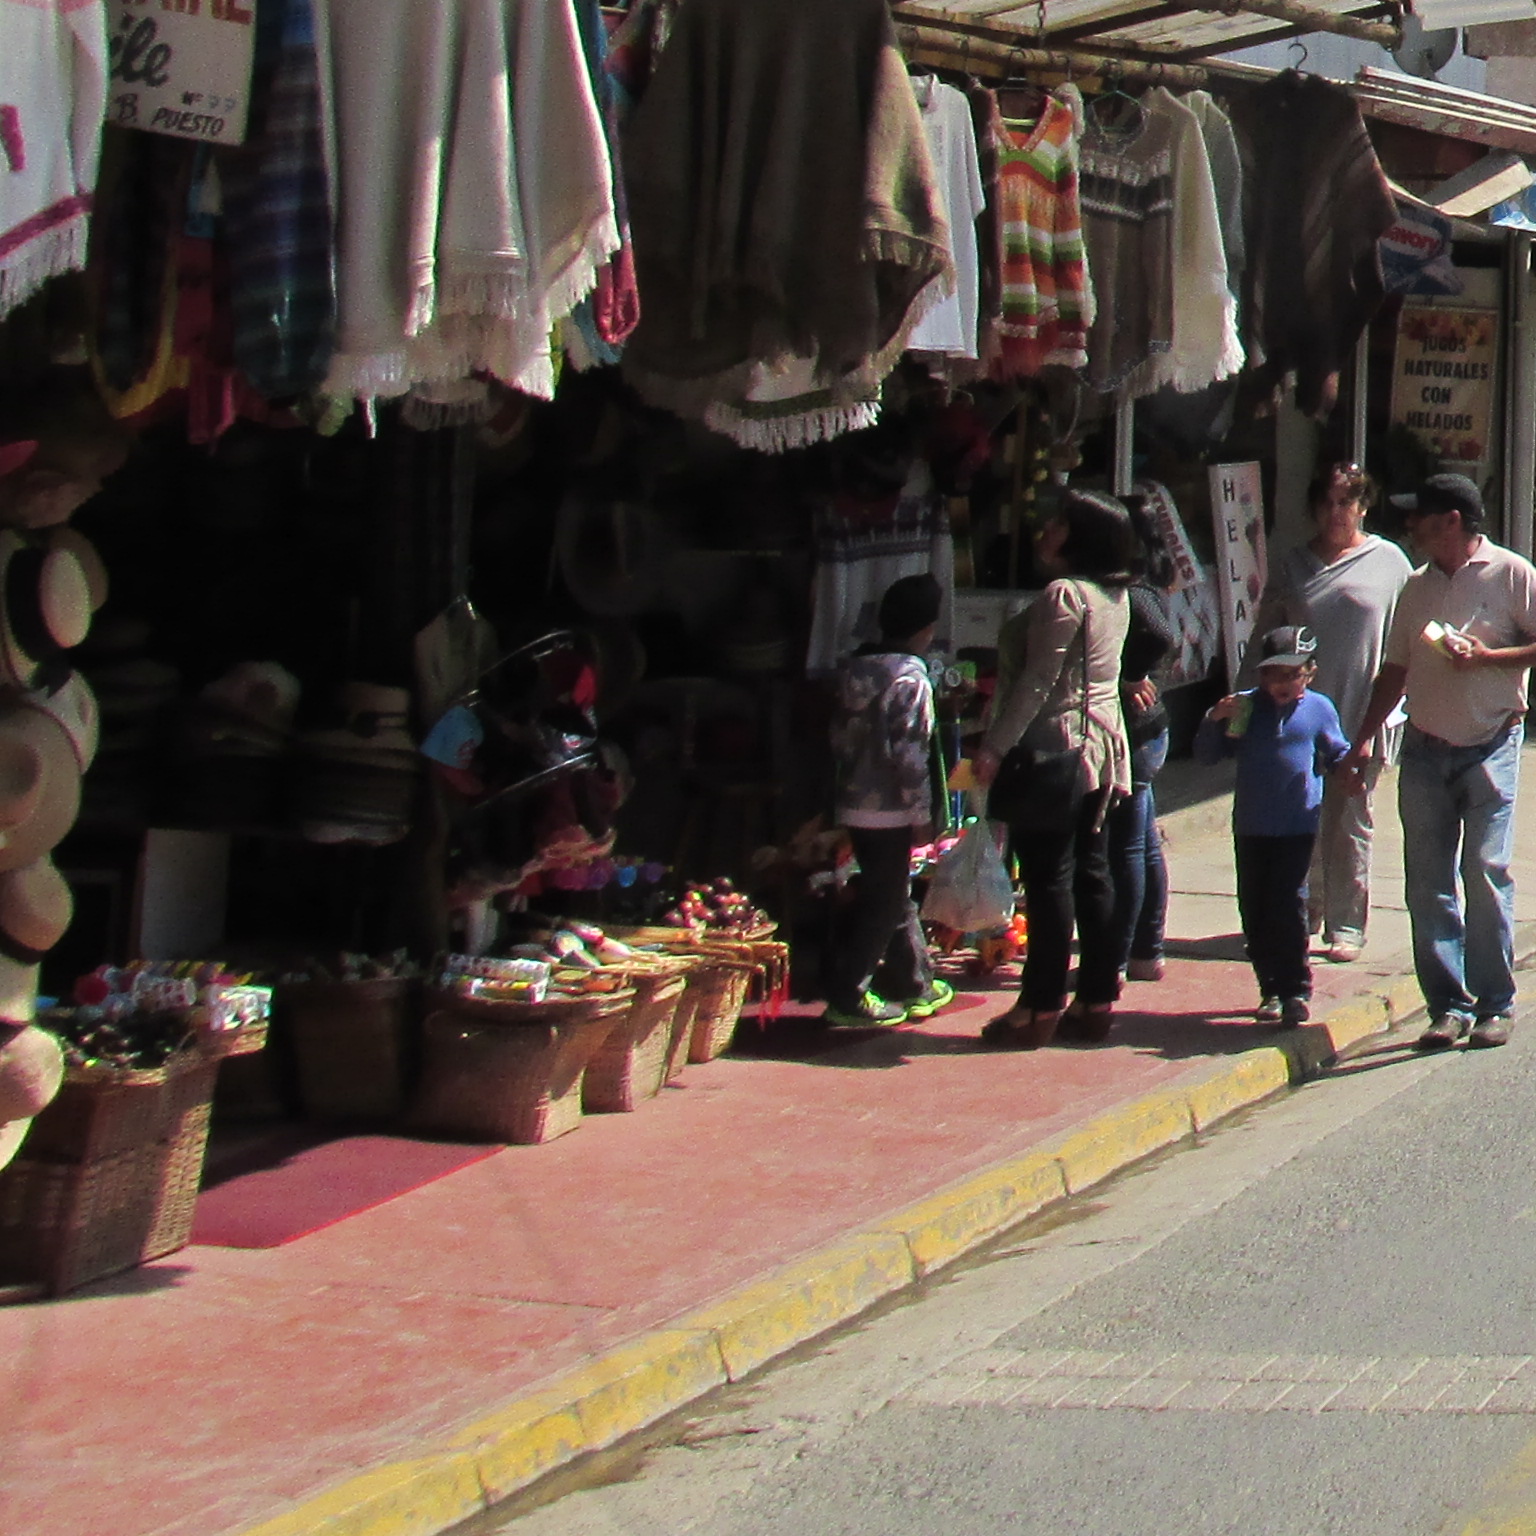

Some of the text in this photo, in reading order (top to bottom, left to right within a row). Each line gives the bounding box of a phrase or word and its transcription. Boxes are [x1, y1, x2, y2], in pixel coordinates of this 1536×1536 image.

[150, 106, 226, 137] PUESTO
[1421, 334, 1467, 353] JUGOS
[1404, 359, 1489, 381] NATURALES
[1421, 386, 1452, 405] CON
[1406, 411, 1474, 431] HELADOS
